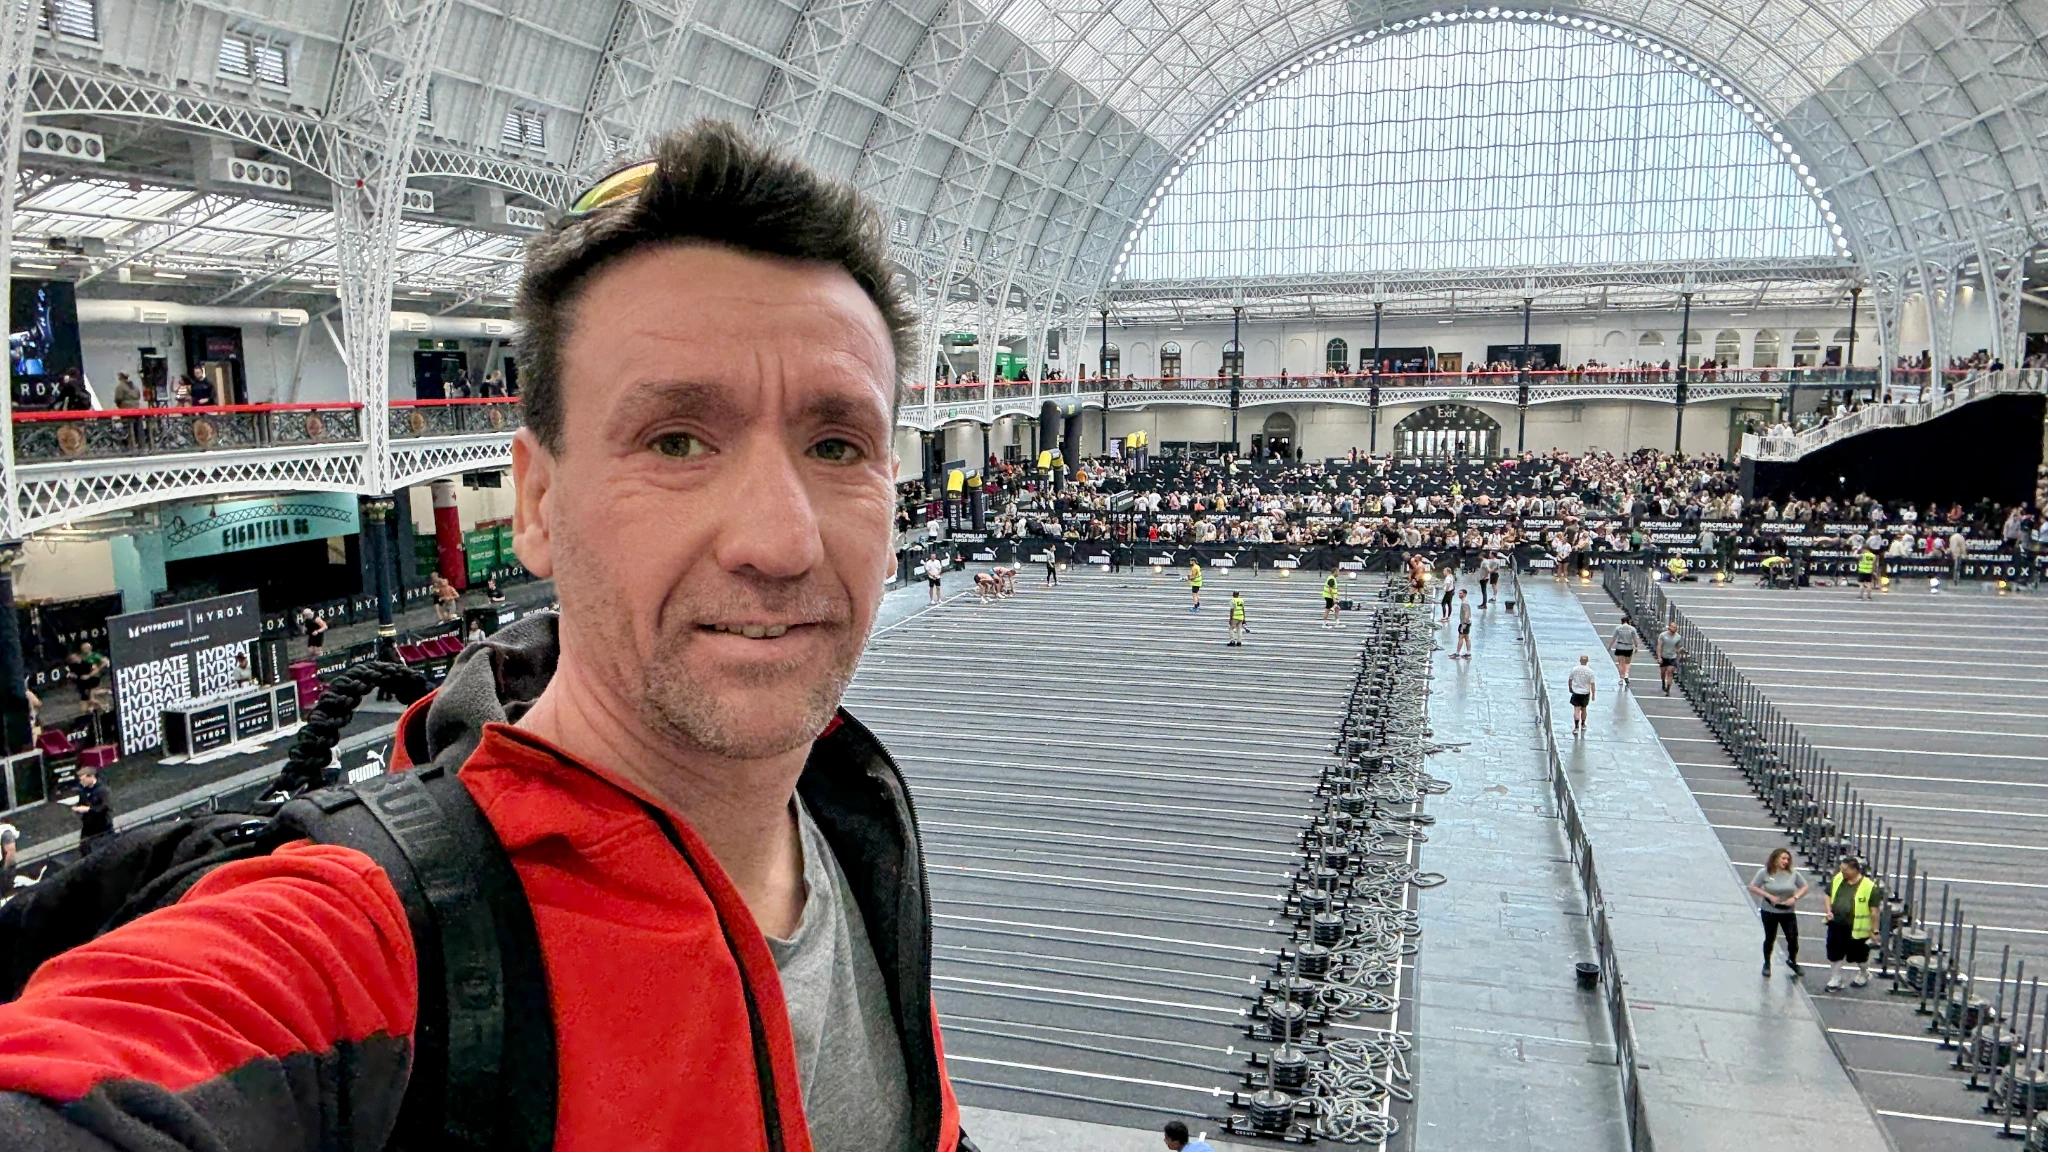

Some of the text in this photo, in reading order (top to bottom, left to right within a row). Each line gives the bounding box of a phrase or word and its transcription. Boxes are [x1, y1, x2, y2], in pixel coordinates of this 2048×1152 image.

[20, 382, 61, 396] ROX
[1437, 408, 1457, 418] Exit
[222, 519, 289, 547] EIGHTEEN
[1148, 556, 1172, 565] PUMA
[1210, 558, 1234, 567] PUMA
[1273, 559, 1298, 569] PUMA
[1339, 561, 1364, 570] PUMA
[1529, 559, 1555, 568] PUMA
[1660, 559, 1719, 569] HROX
[1965, 565, 2030, 576] HYROX
[141, 605, 243, 633] MYPROTEIN HYROX
[296, 605, 345, 624] HROX
[116, 653, 188, 684] HYDRATE
[118, 668, 190, 698] HYDRATE
[120, 682, 191, 713] HYDRATE
[240, 715, 268, 729] HYROX
[195, 728, 226, 742] HYROX
[348, 761, 385, 785] PUMA
